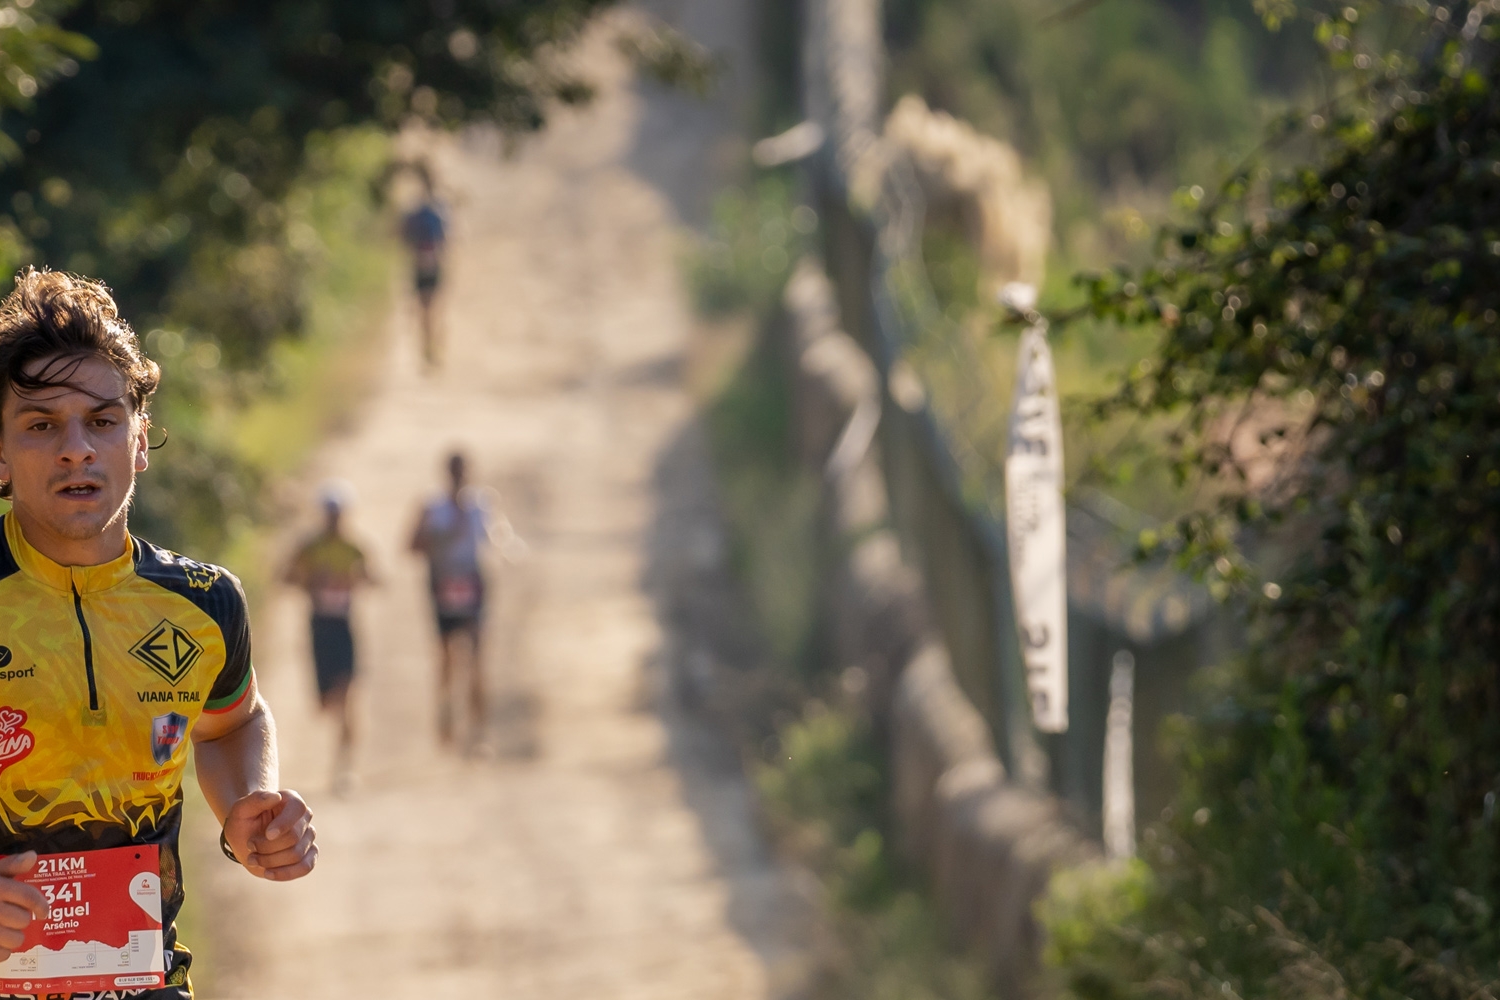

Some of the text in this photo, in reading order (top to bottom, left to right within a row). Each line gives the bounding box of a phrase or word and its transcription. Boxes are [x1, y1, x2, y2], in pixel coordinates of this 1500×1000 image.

[136, 690, 201, 703] VIANA TRAIL
[37, 856, 85, 874] 21KM
[40, 881, 83, 904] 341
[31, 901, 90, 923] iguel
[42, 919, 80, 931] Arsénio
